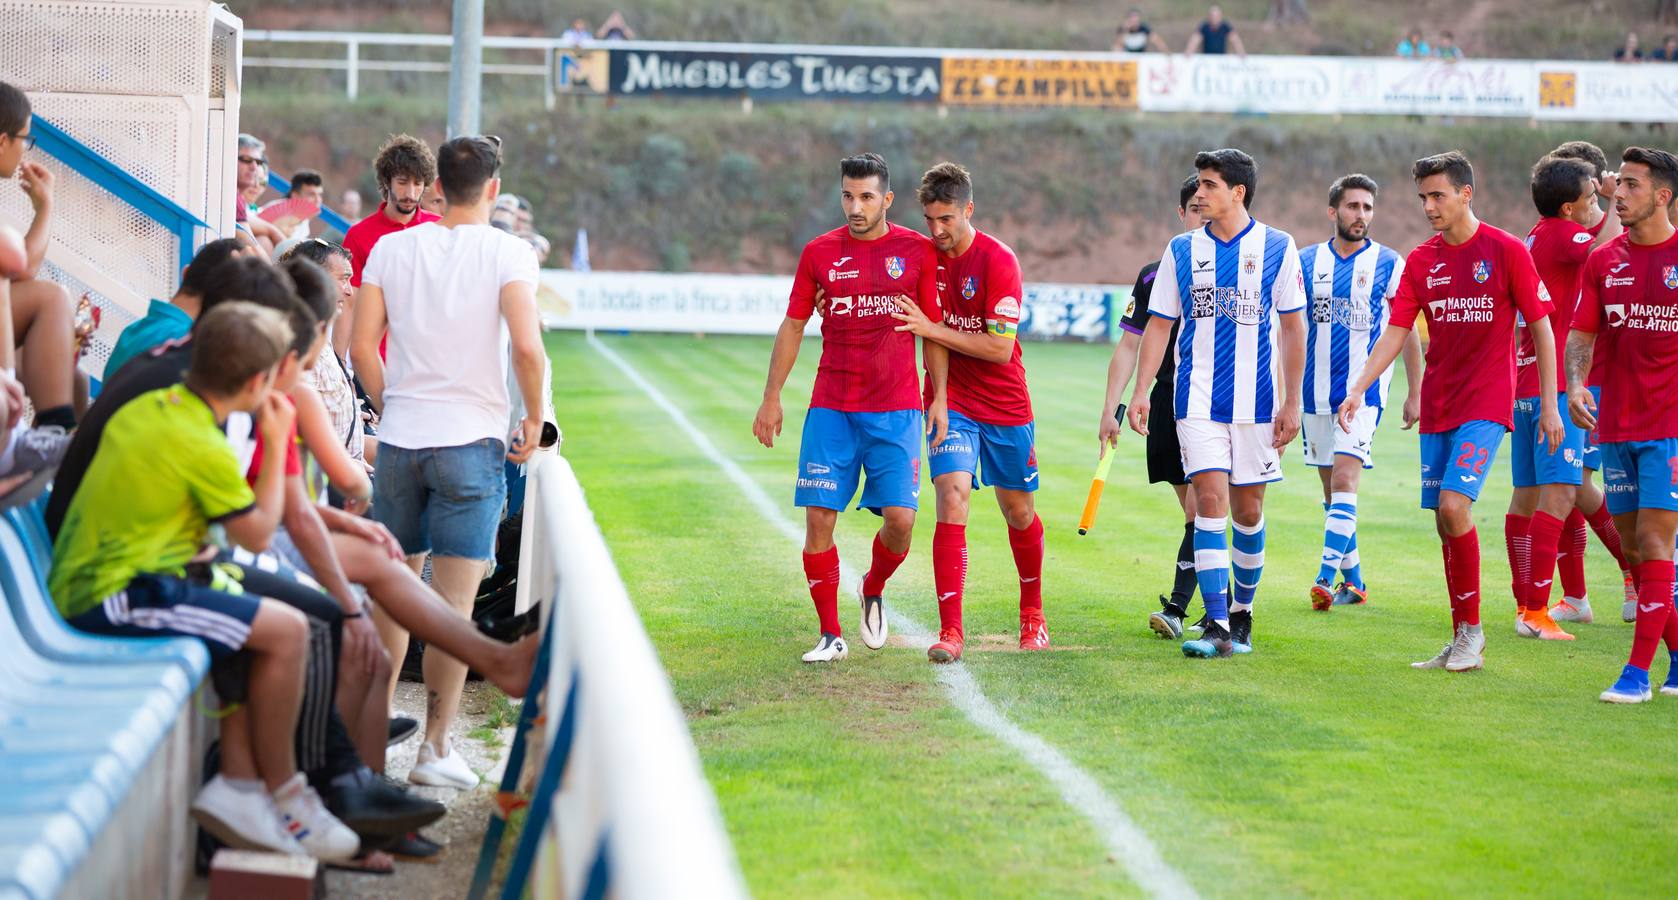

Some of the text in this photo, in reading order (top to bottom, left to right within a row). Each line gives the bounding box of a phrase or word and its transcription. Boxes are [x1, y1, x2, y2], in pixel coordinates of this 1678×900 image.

[620, 52, 940, 95] MUEBLES TUESTA
[952, 77, 1131, 97] EL CAMPILLO
[599, 286, 642, 311] boda
[1217, 286, 1250, 301] REAL
[1447, 294, 1494, 310] MARQUÉS
[857, 308, 875, 318] DEL
[1446, 309, 1493, 322] DEL ATRIO
[1628, 316, 1678, 332] DEL ATRIO
[1455, 441, 1489, 476] 22
